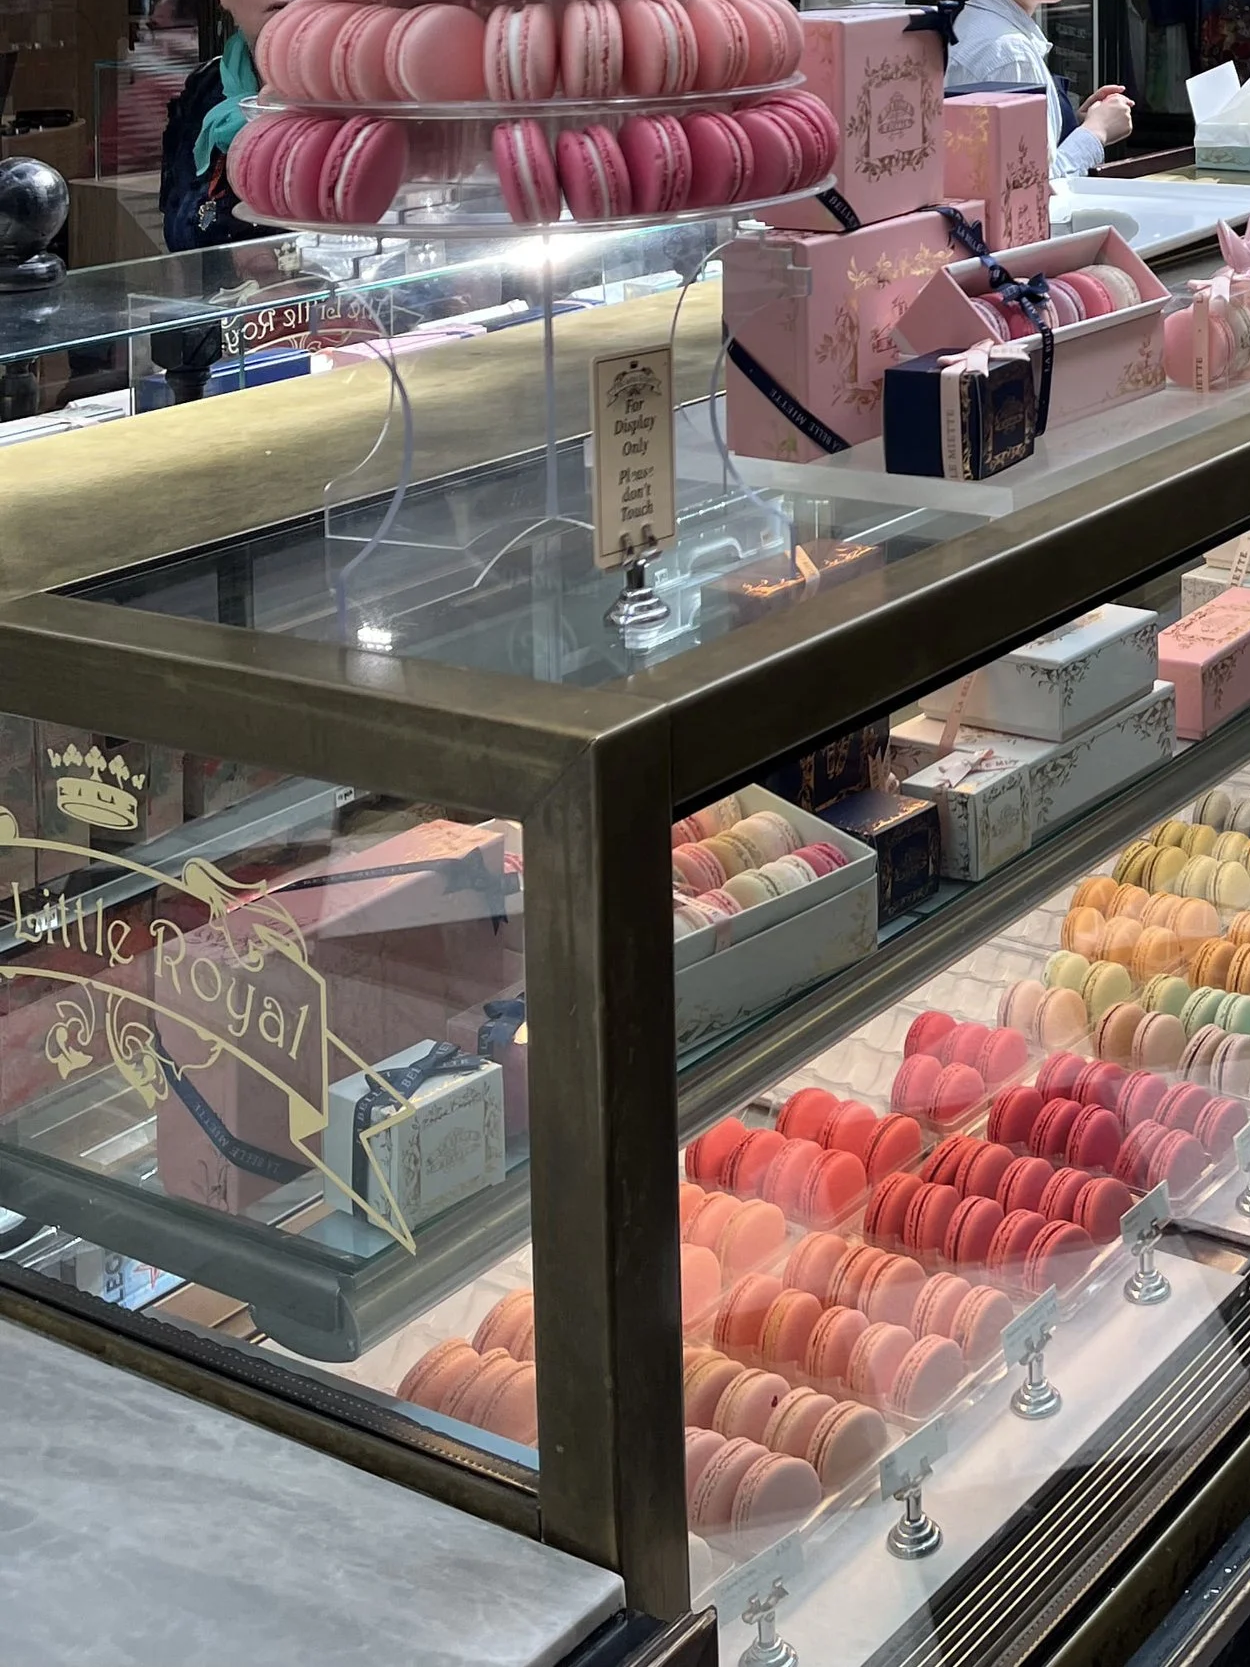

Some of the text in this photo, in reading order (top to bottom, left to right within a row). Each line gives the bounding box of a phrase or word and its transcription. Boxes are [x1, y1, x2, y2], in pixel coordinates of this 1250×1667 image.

[1195, 357, 1204, 391] IETTE
[624, 397, 645, 415] For
[769, 387, 808, 426] MIETTE
[614, 414, 657, 435] Display
[948, 409, 957, 461] MIETTE
[622, 439, 650, 457] Only
[618, 465, 655, 486] Please
[621, 483, 652, 503] don't
[620, 500, 654, 523] Touch
[1230, 551, 1248, 587] IETTE
[11, 880, 310, 1061] Little Royal
